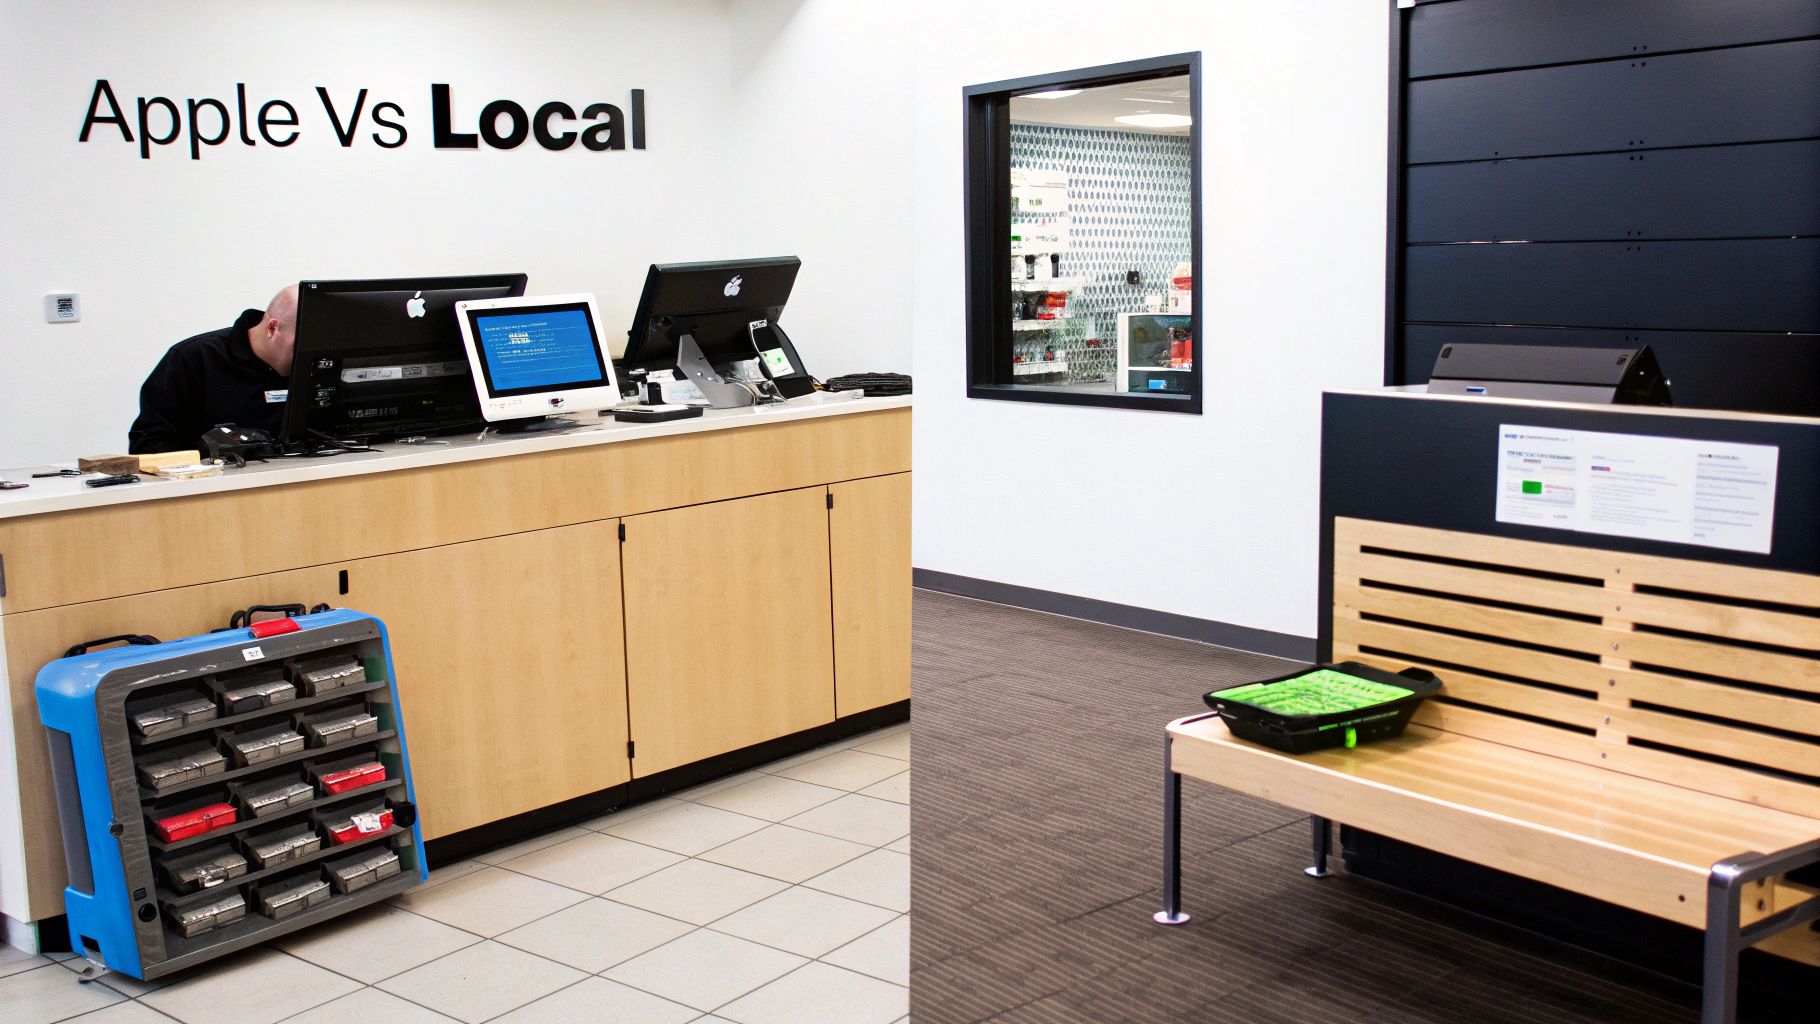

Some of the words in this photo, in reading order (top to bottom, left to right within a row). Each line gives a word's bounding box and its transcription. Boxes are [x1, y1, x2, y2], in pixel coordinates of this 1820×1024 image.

[79, 79, 301, 160] Apple
[315, 86, 408, 149] Vs
[431, 83, 647, 151] Local
